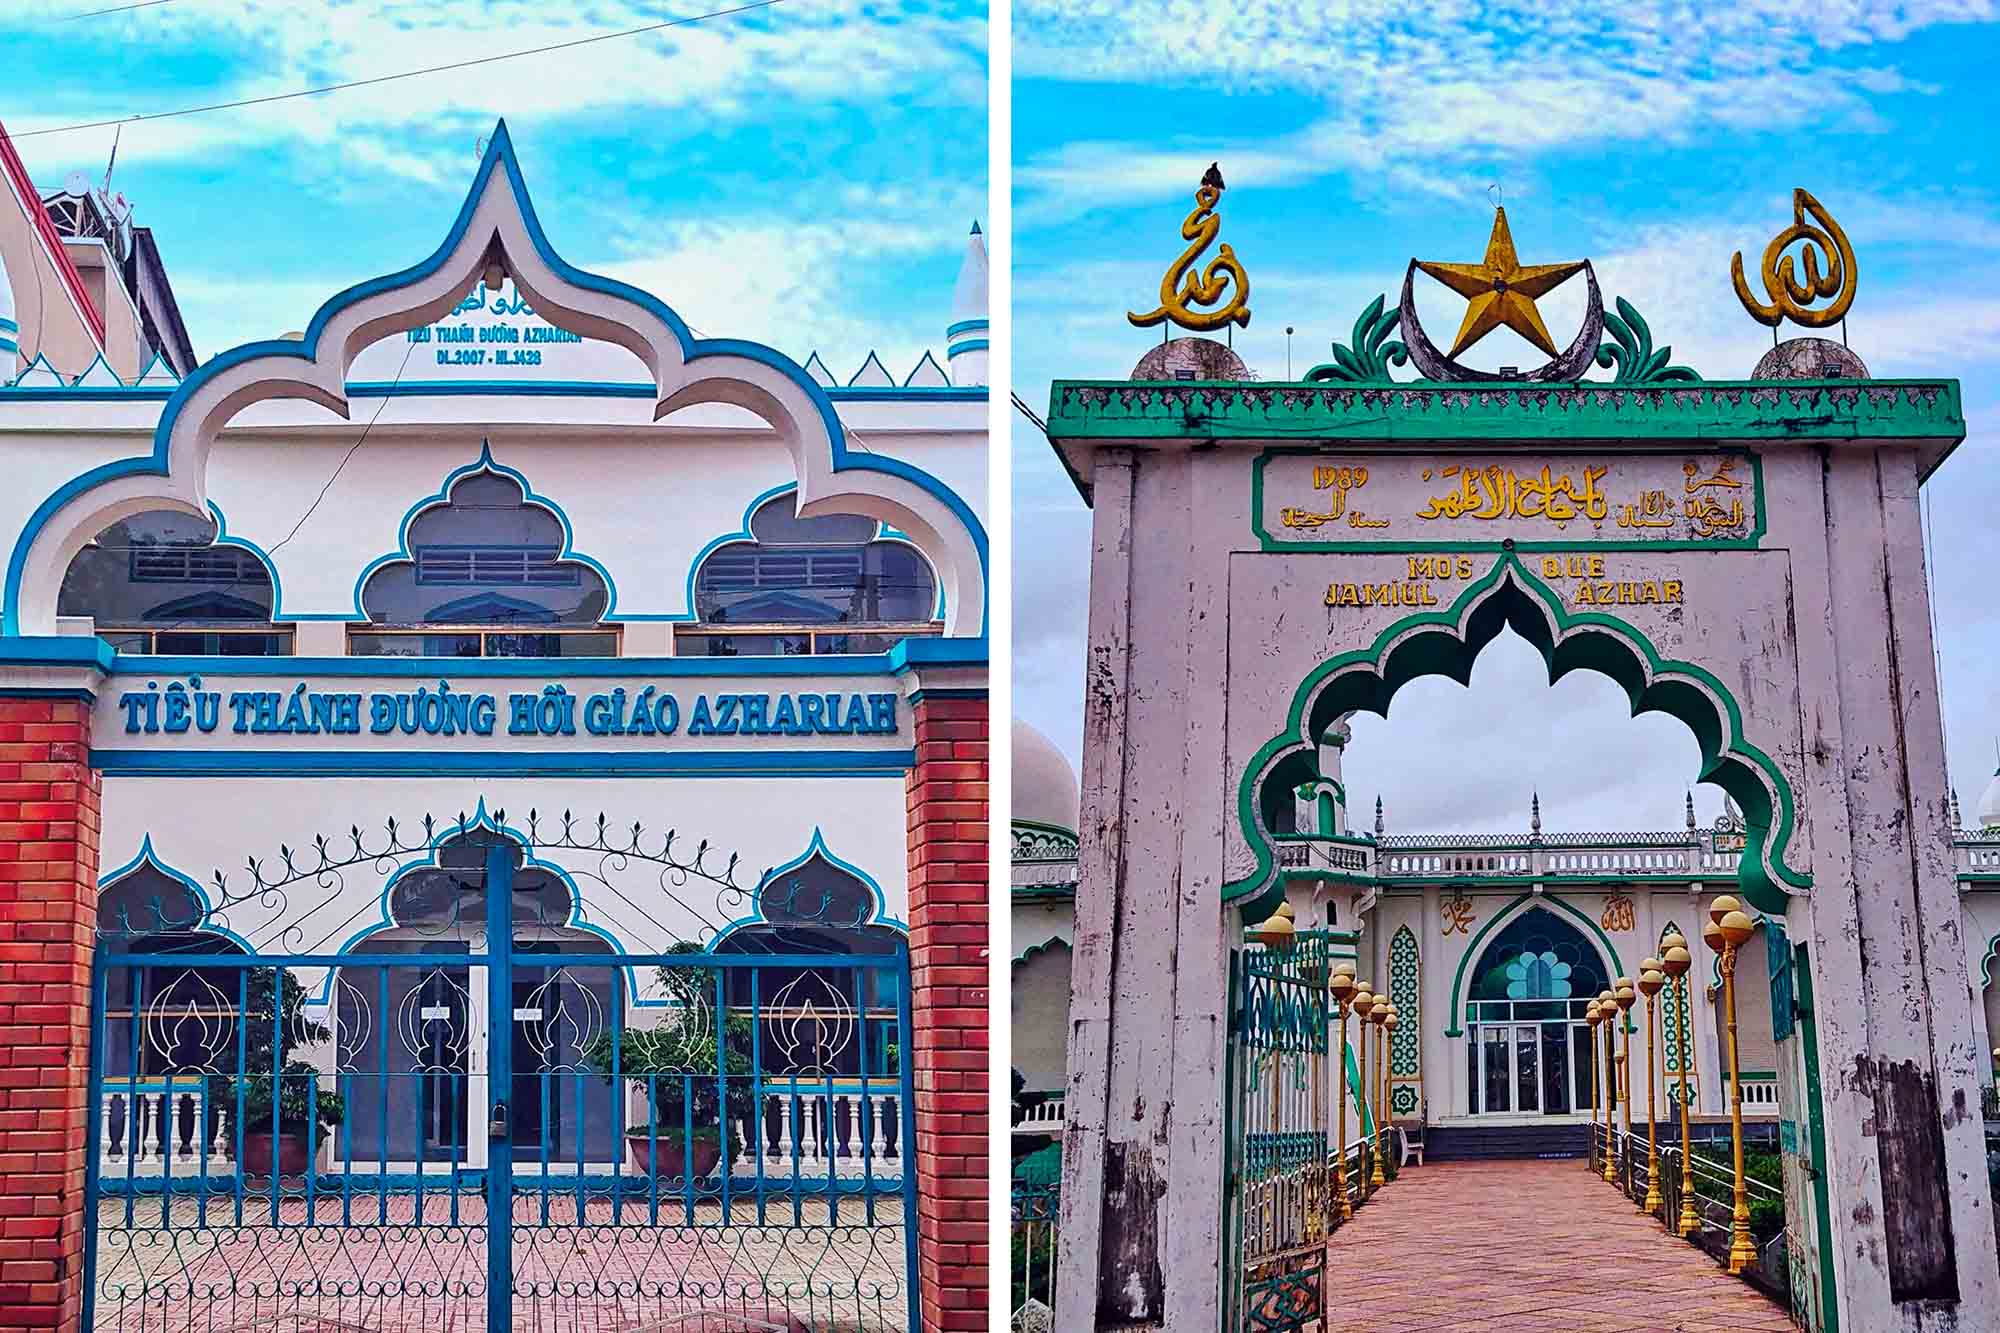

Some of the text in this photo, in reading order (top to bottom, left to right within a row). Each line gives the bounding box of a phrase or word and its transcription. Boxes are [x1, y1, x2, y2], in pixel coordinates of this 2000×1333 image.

[1313, 464, 1369, 490] 1989
[1407, 556, 1605, 579] MOS QUE
[1574, 580, 1684, 605] AZHAR
[229, 682, 362, 734] THÁNH
[584, 686, 680, 735] GIÁO
[688, 693, 899, 735] AZHARIAH
